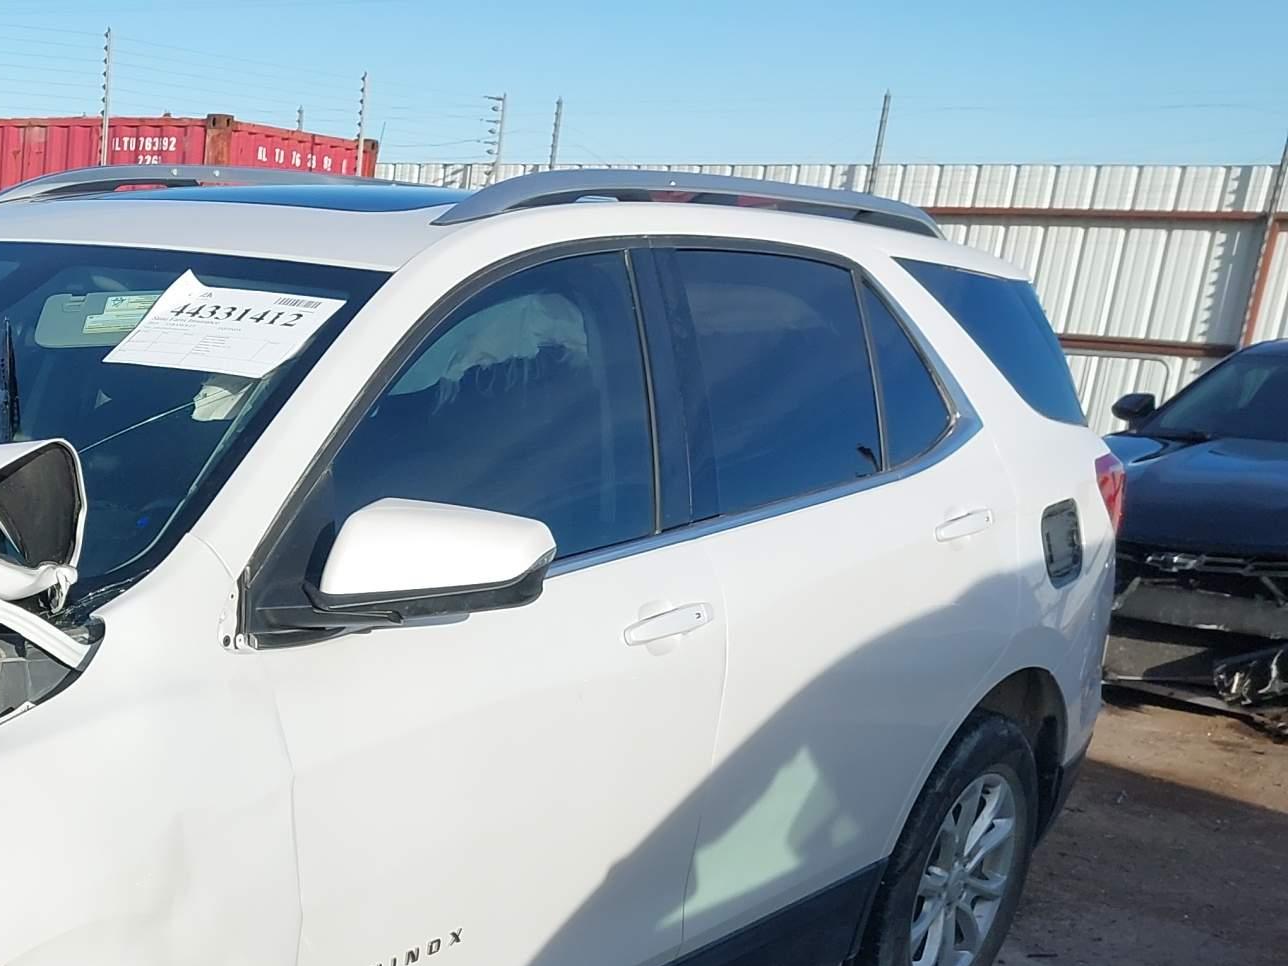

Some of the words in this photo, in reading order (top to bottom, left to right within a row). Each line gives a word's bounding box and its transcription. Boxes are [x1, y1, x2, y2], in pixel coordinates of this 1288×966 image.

[112, 136, 136, 151] LTU
[138, 136, 177, 152] 76392
[170, 303, 304, 327] 44331412
